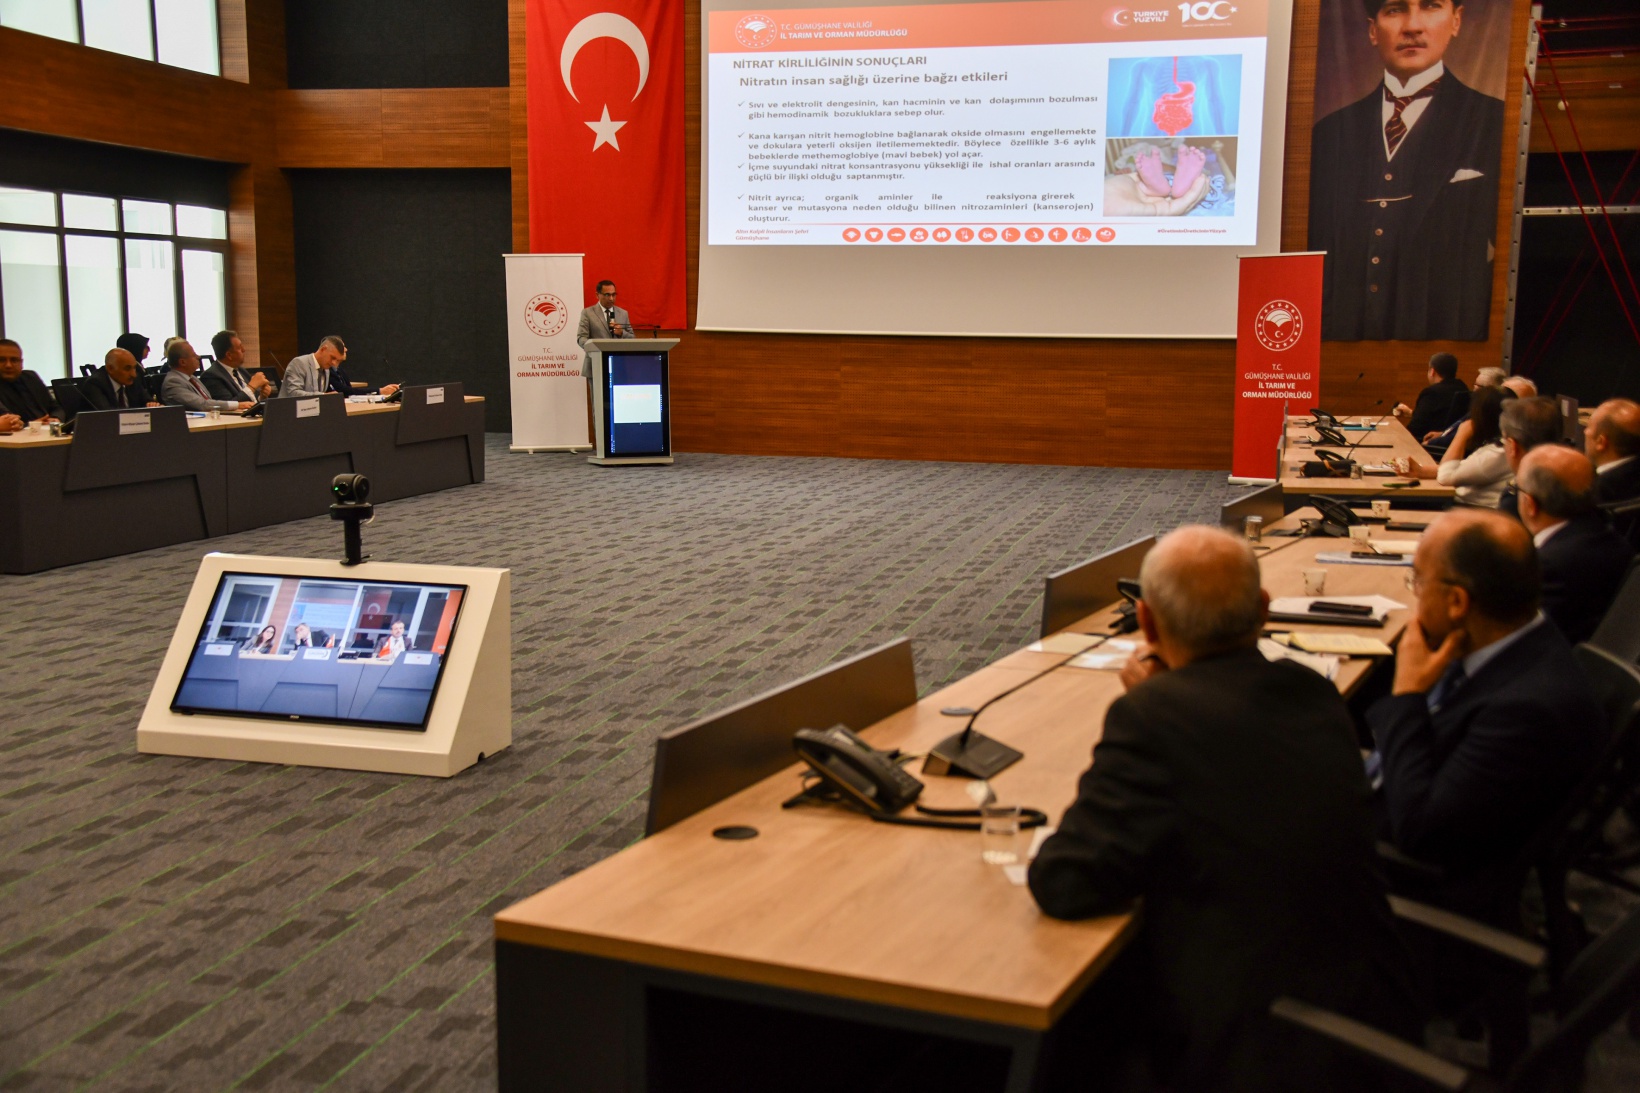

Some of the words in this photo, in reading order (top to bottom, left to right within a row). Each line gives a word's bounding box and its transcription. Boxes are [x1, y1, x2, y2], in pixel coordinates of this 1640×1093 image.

[794, 22, 842, 31] GÜMÜŞHANE
[844, 21, 872, 29] VALİLİĞİ
[780, 32, 787, 40] İL
[856, 29, 908, 38] MÜDÜRLÜĞÜ
[733, 58, 774, 68] NİTRAT
[778, 57, 854, 68] KİRLİLİĞİNİN
[856, 56, 926, 68] SONUÇLARI
[740, 76, 788, 86] Nitratın
[792, 76, 825, 86] insan
[829, 75, 868, 86] sağlığı
[873, 74, 920, 84] üzerine
[924, 72, 957, 84] bağzı
[962, 72, 1008, 82] etkileri
[827, 100, 878, 109] dengesinin,
[990, 96, 1044, 106] dolaşımının
[748, 112, 764, 120] gibi
[894, 110, 922, 118] sebep
[774, 132, 806, 140] karışan
[834, 131, 894, 140] hemoglobine
[897, 130, 948, 139] bağlanarak
[1031, 128, 1096, 137] engellemekte
[806, 142, 835, 150] yeterli
[840, 142, 872, 150] oksijen
[876, 140, 960, 148] iletilememektedir.
[964, 140, 1001, 148] Böylece
[1074, 138, 1096, 147] aylık
[802, 152, 879, 160] methemoglobiye
[882, 151, 908, 159] (mavi
[945, 151, 958, 159] yol
[749, 162, 770, 171] İçme
[772, 162, 818, 171] suyundaki
[849, 162, 920, 170] konsantrasyonu
[924, 161, 969, 170] yüksekliği
[1054, 160, 1095, 168] arasında
[748, 174, 772, 182] güçlü
[788, 172, 808, 182] ilişki
[811, 172, 842, 182] olduğu
[846, 172, 904, 181] saptanmıştır.
[776, 194, 804, 203] ayrıca;
[825, 194, 858, 202] organik
[986, 193, 1037, 201] reaksiyona
[1042, 193, 1074, 201] girerek
[798, 204, 848, 212] mutasyona
[887, 204, 918, 212] olduğu
[1033, 202, 1094, 211] (kanserojen)
[1244, 372, 1284, 380] GÜMÜŞHANE
[1268, 391, 1312, 399] MÜDÜRLÜĞÜ
